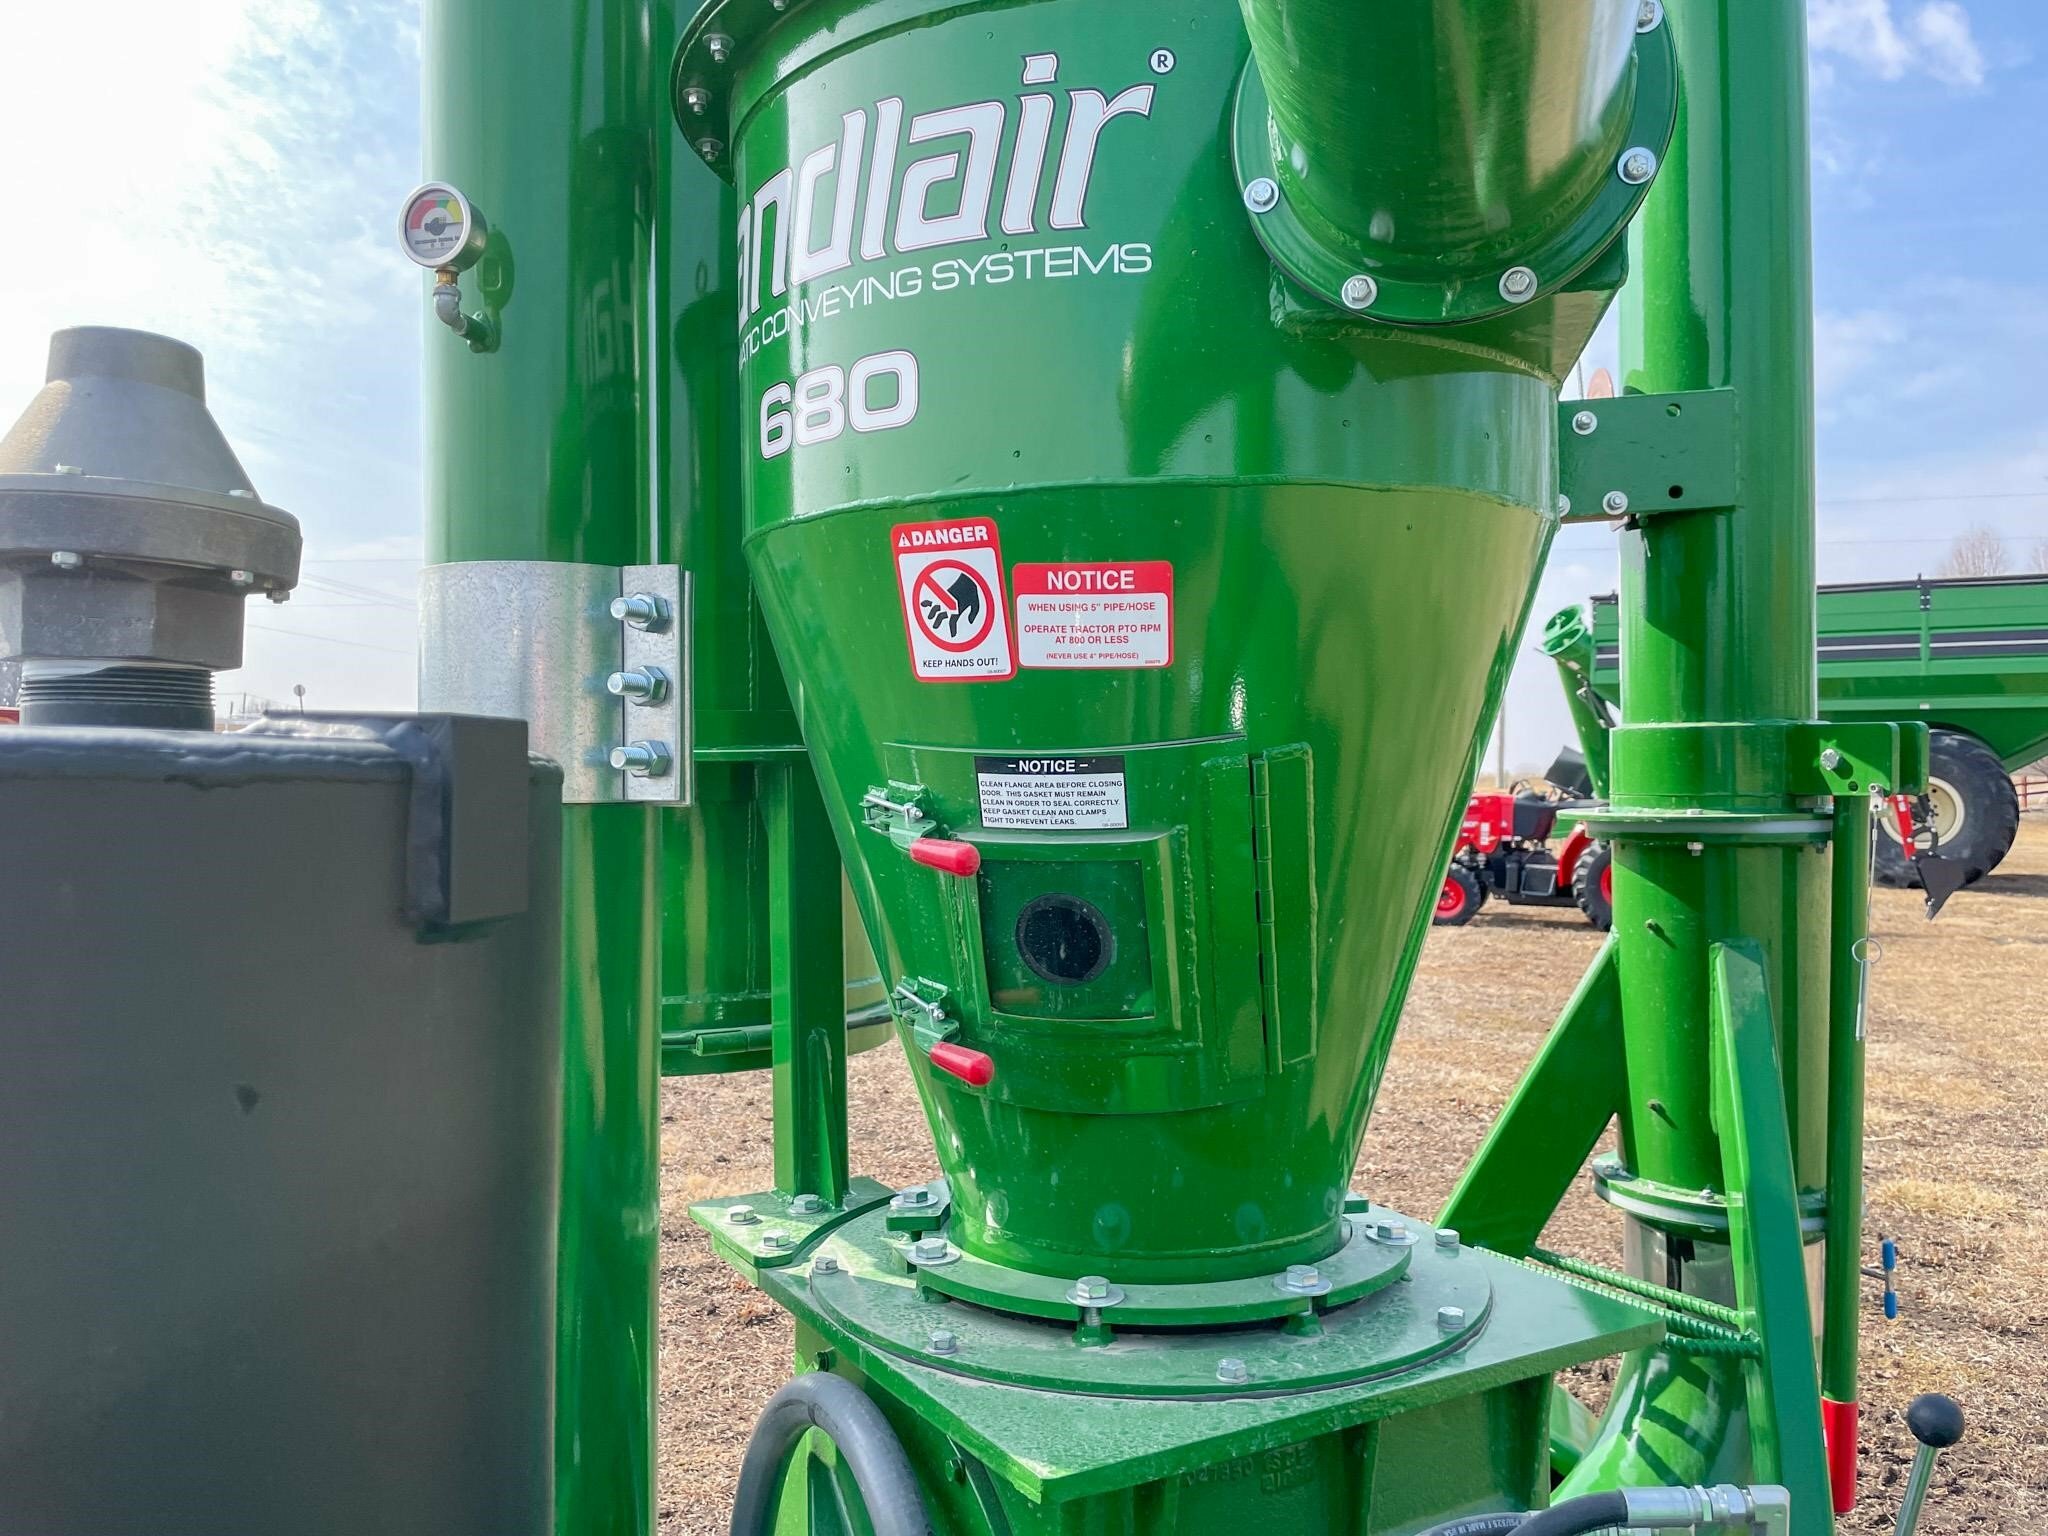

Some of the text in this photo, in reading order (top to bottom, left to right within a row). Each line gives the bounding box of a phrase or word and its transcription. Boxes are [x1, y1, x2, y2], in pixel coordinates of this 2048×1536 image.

[763, 266, 923, 345] CONVEYING
[932, 242, 1153, 290] SYSTEMS
[760, 349, 919, 459] 680
[911, 525, 989, 546] DANGER
[1047, 570, 1135, 590] NOTICE
[1028, 603, 1056, 612] WHEN
[1058, 603, 1089, 612] USING
[1103, 602, 1156, 611] PIPE/HOSE
[1024, 623, 1161, 633] OPERATE TRACTOR PTO RPM
[1055, 635, 1129, 644] AT 800 OR LESS
[1046, 652, 1072, 660] (NEVER
[1098, 652, 1139, 660] PIPE/HOSE)
[922, 657, 999, 668] KEEP HANDS OUT!
[1018, 759, 1076, 773] NOTICE
[980, 780, 1003, 788] CLEAN
[1004, 781, 1033, 789] FLANGE
[1056, 781, 1087, 789] BEFORE
[1088, 780, 1123, 788] CLOSING
[982, 798, 1005, 806] CLEAN
[983, 807, 1001, 815] KEEP
[1002, 808, 1030, 816] GASKET
[1075, 808, 1107, 816] CLAMPS
[984, 816, 1004, 824] TIGHT
